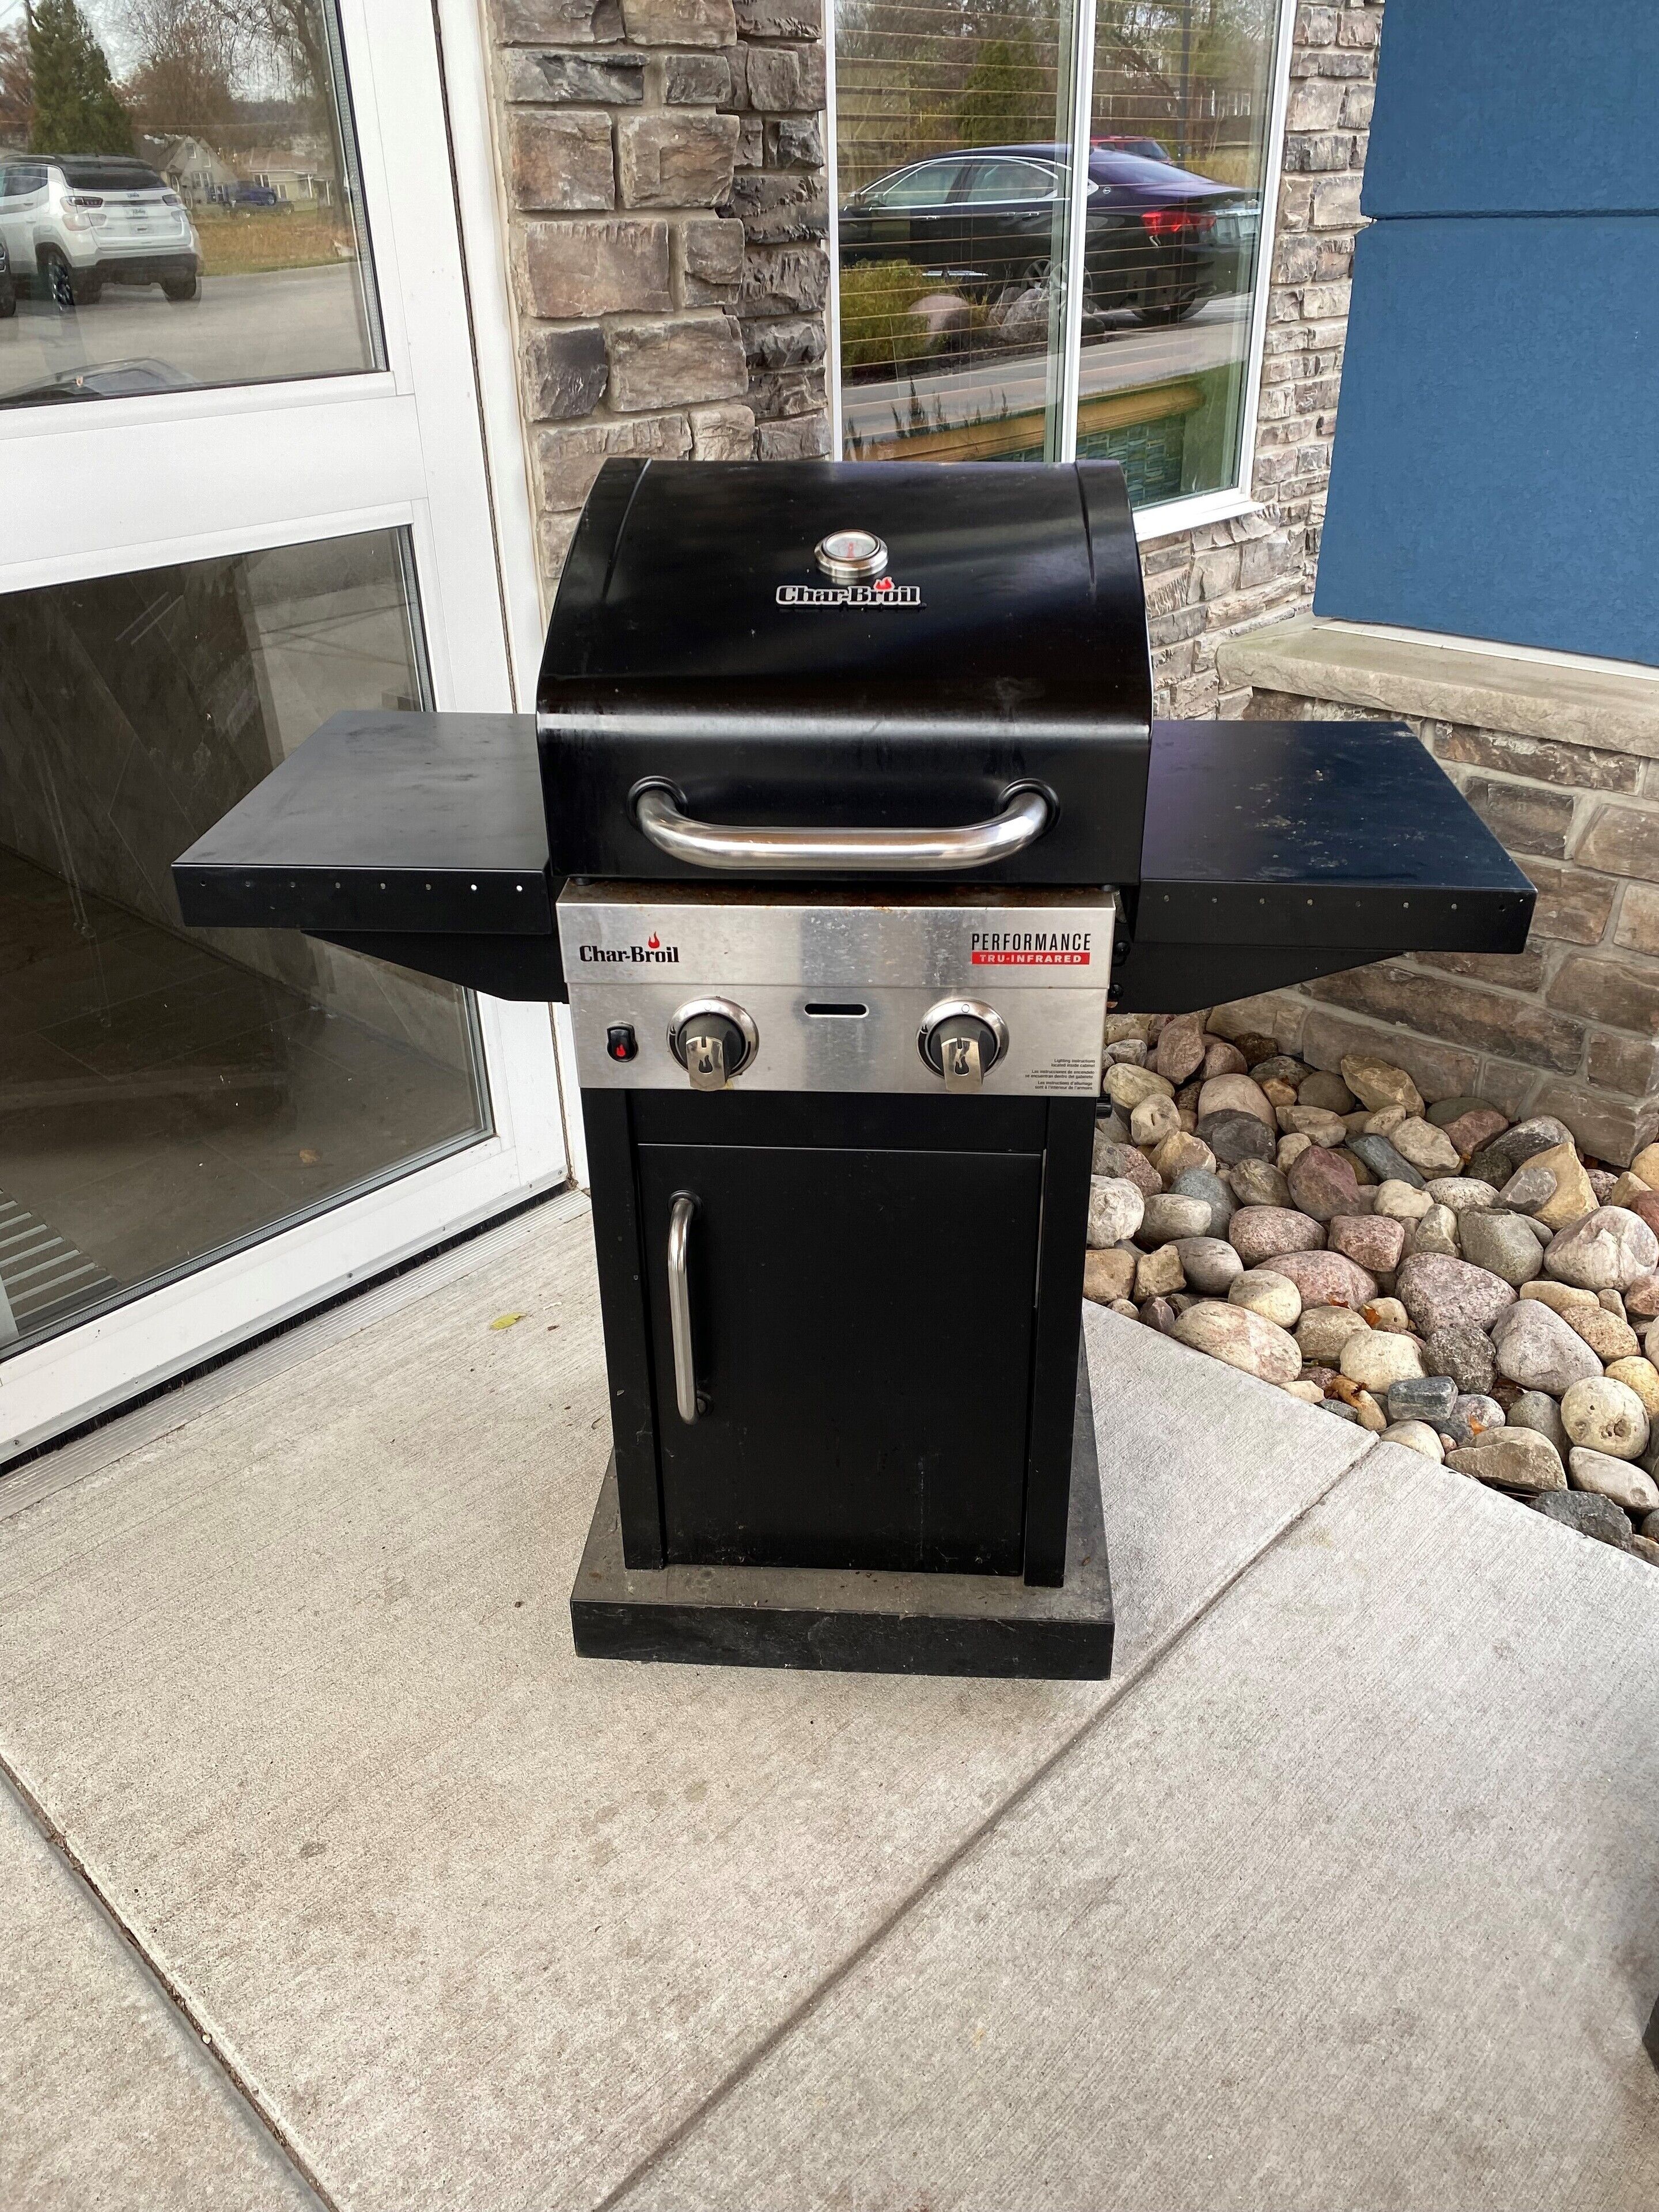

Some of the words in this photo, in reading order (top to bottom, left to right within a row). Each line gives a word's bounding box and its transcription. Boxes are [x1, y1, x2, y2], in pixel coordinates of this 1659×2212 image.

[777, 585, 921, 605] Char-Broil
[971, 933, 1091, 951] PERFORMANCE
[579, 945, 680, 963] Char-Broil
[979, 954, 1082, 964] TRU-INFRARED
